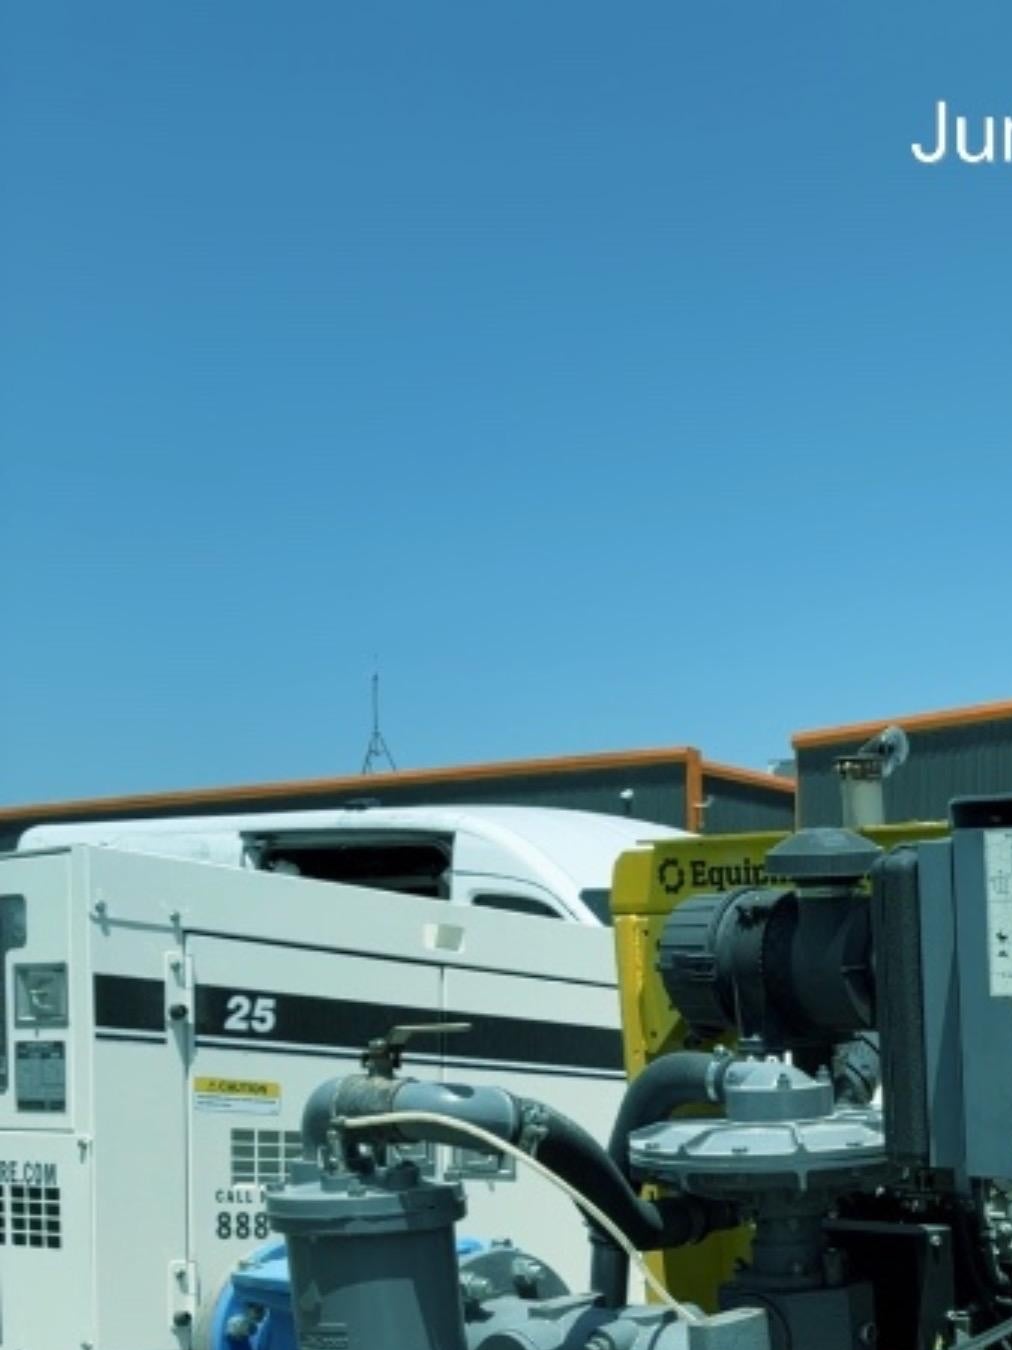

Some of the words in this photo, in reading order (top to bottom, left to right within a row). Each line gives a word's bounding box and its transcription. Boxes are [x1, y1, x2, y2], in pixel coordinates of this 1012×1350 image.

[689, 856, 791, 892] Equip
[223, 994, 278, 1033] 25
[214, 1190, 253, 1204] CALL
